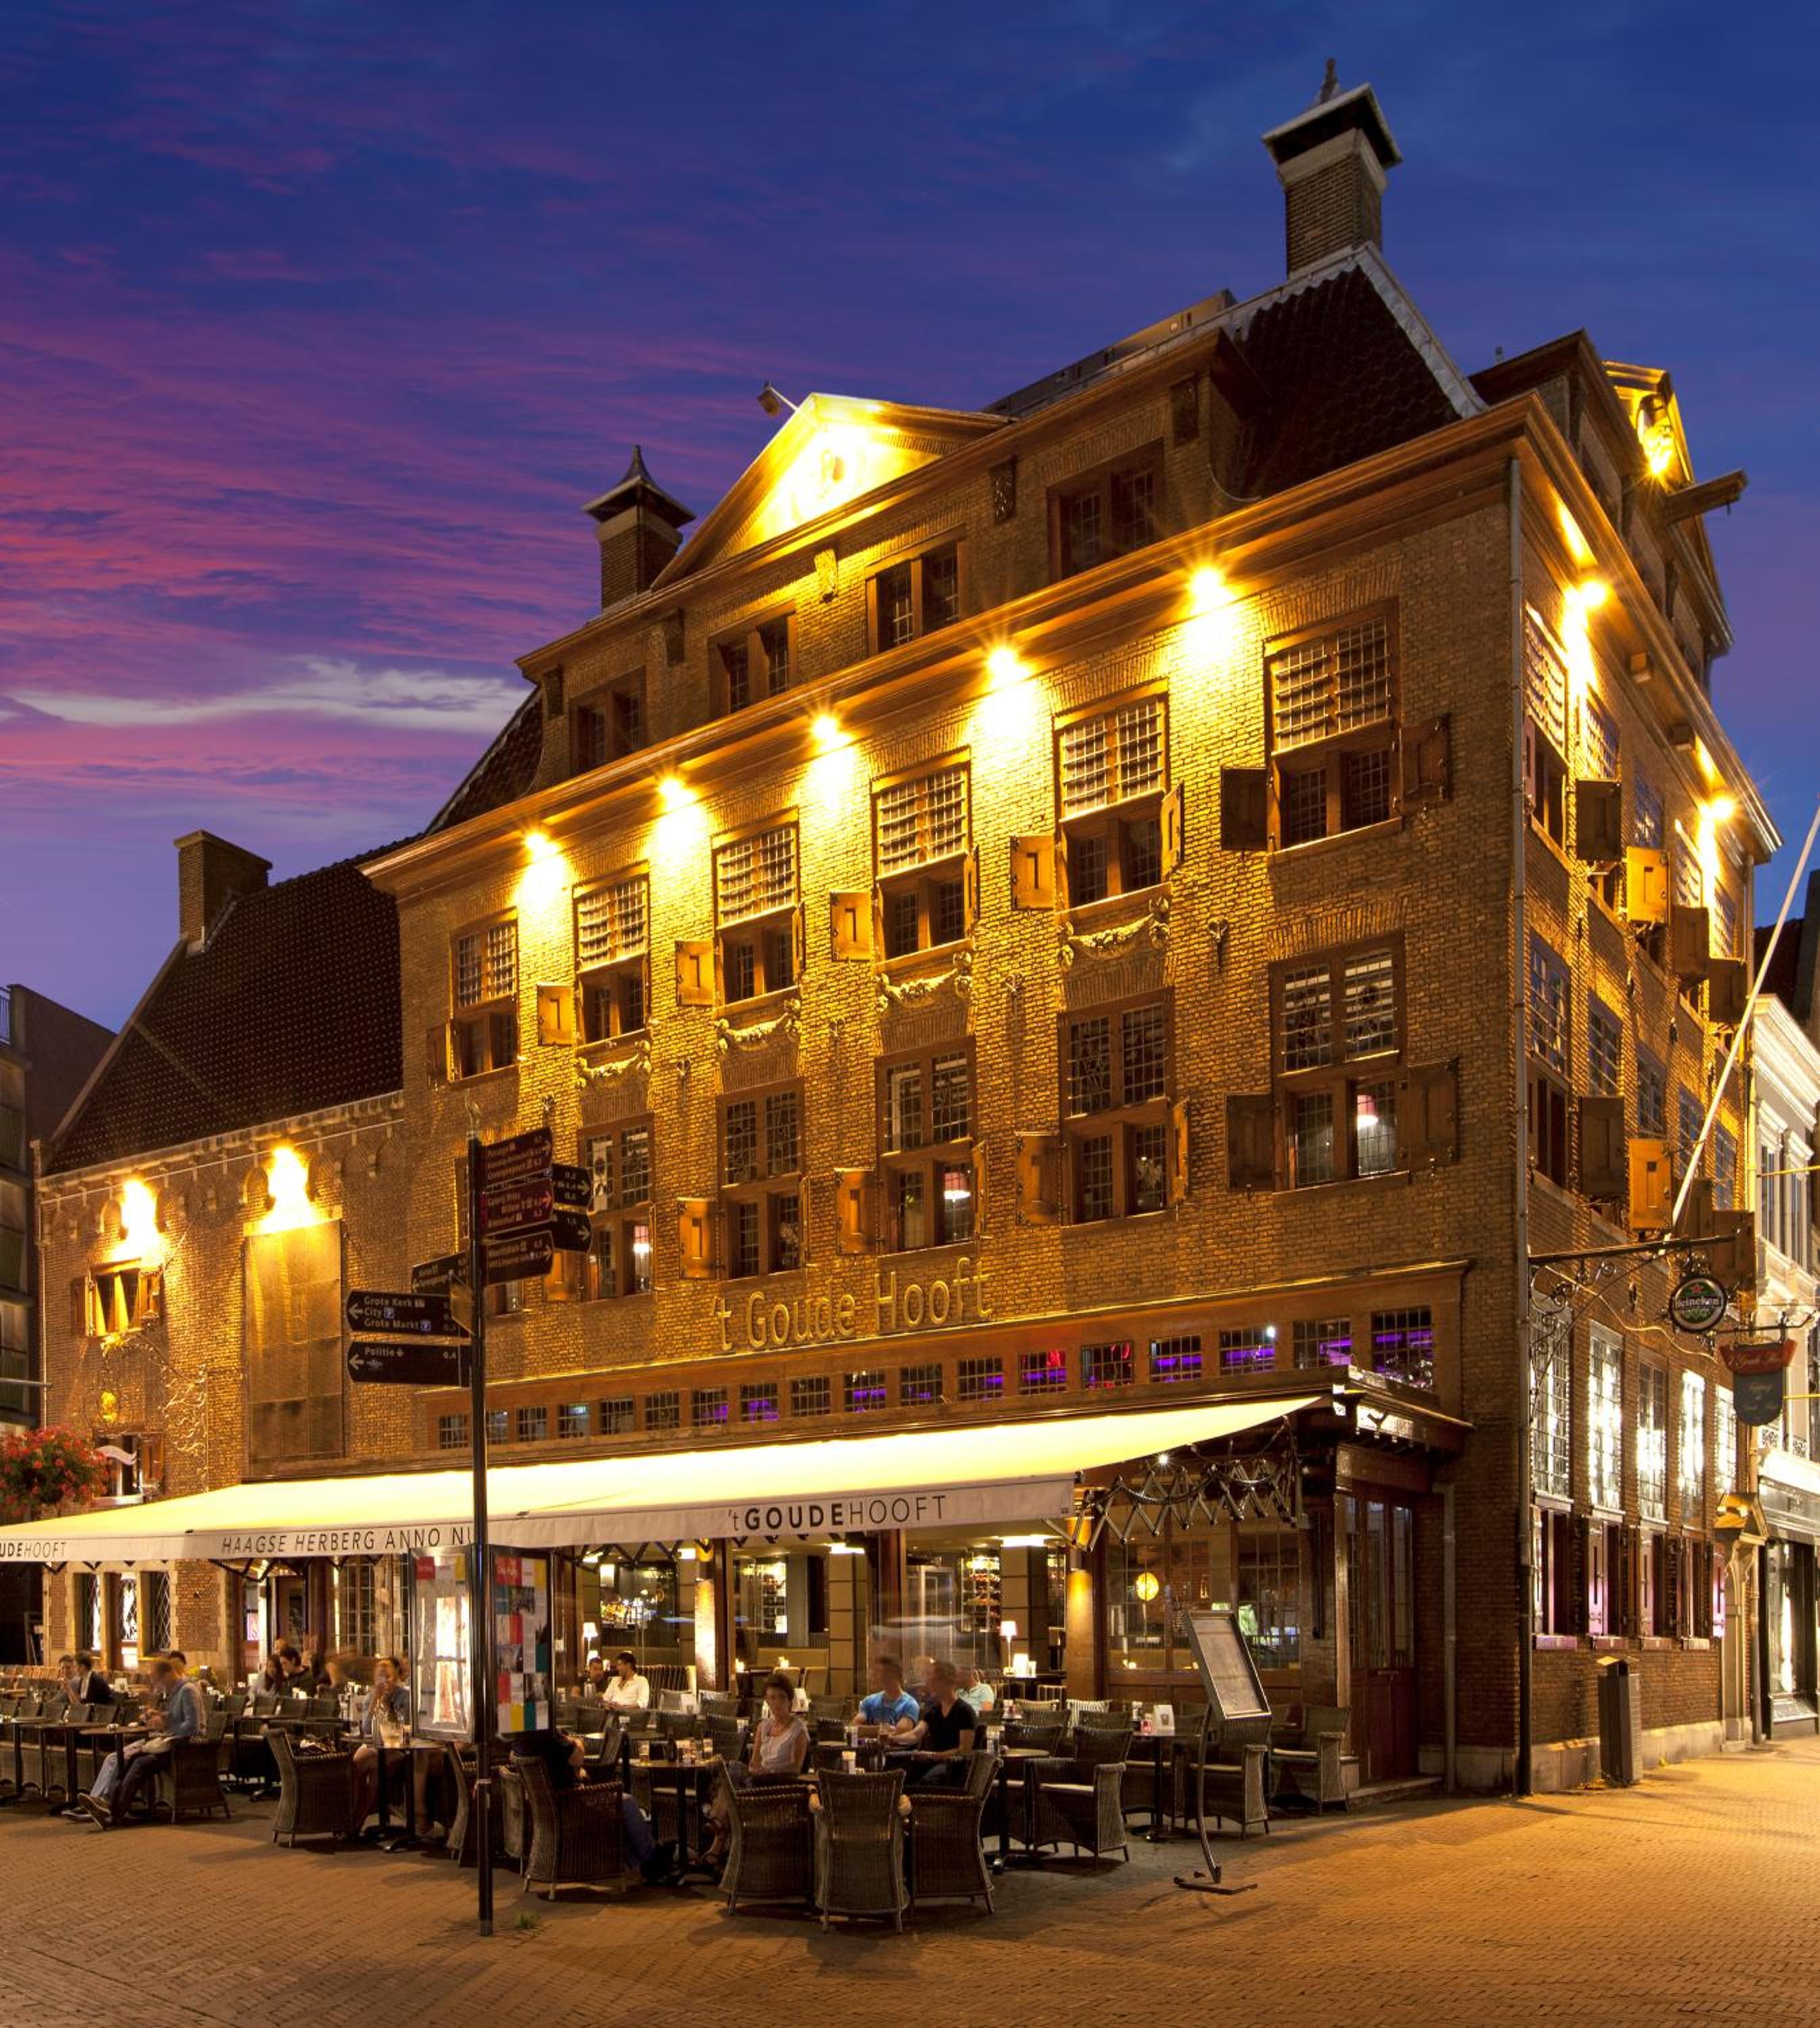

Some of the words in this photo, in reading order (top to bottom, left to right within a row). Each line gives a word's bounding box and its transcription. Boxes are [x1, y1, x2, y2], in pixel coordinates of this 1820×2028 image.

[364, 1296, 390, 1305] Grote
[392, 1297, 412, 1307] Kerk
[747, 1278, 857, 1348] Goude
[875, 1257, 992, 1329] Hooft
[1675, 1295, 1720, 1309] Heineken
[364, 1307, 382, 1318] City
[364, 1318, 390, 1328] Grote
[393, 1320, 419, 1328] Markt
[364, 1347, 396, 1357] Politie
[222, 1535, 287, 1554] HAAGSE
[295, 1530, 375, 1553] HERBERG
[385, 1527, 441, 1549] ANNO
